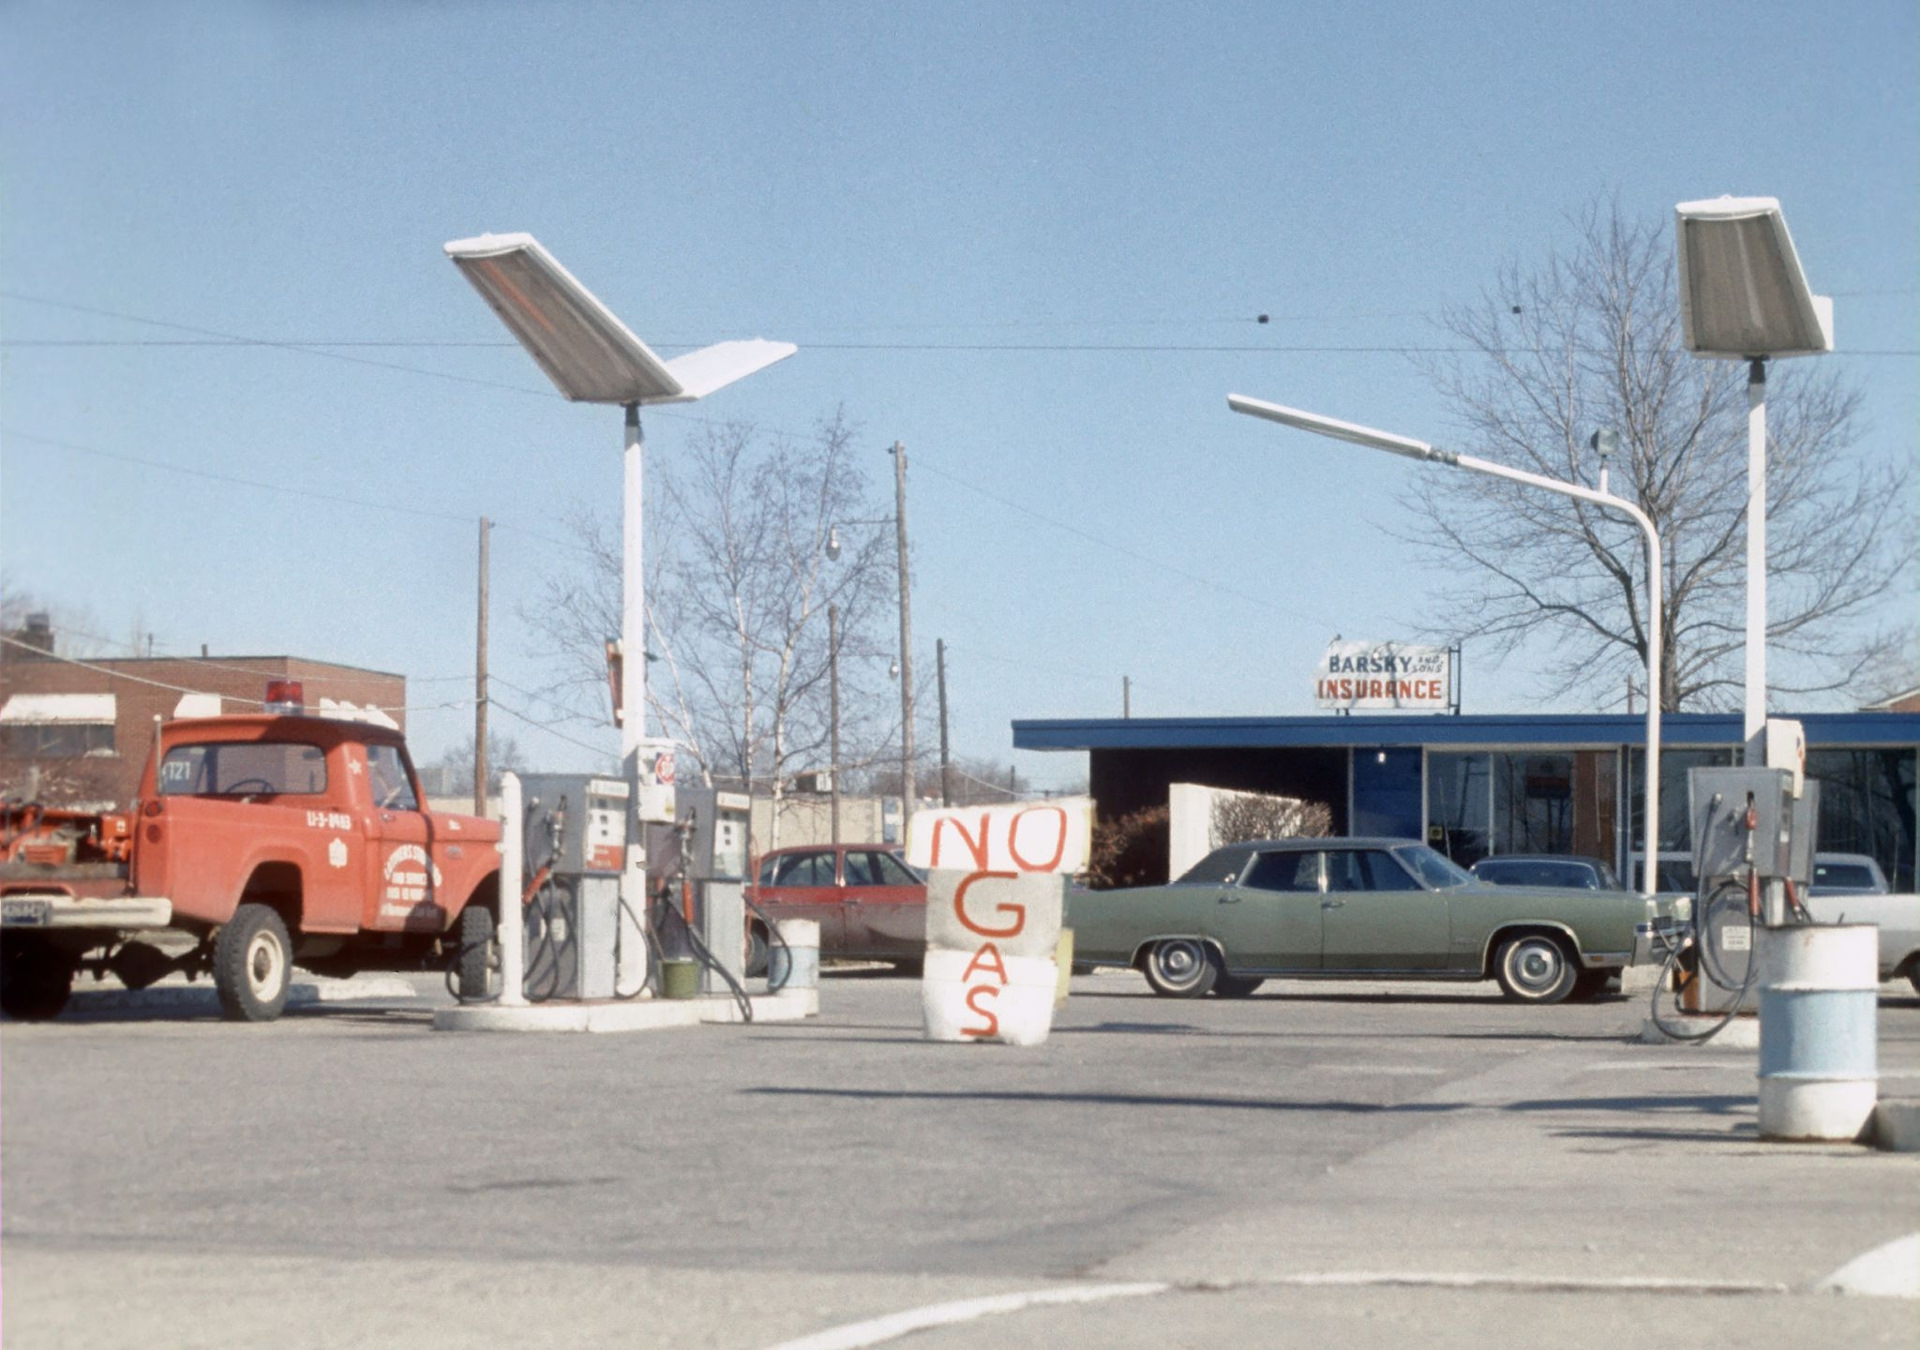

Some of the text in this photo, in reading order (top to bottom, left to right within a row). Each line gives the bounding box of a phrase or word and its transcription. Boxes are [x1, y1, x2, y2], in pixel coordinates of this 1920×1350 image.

[1329, 656, 1412, 674] BARSKY
[1412, 664, 1443, 673] SONS
[1318, 679, 1442, 700] INSURANCE
[930, 807, 1067, 873] NO
[953, 870, 1026, 1037] GAS
